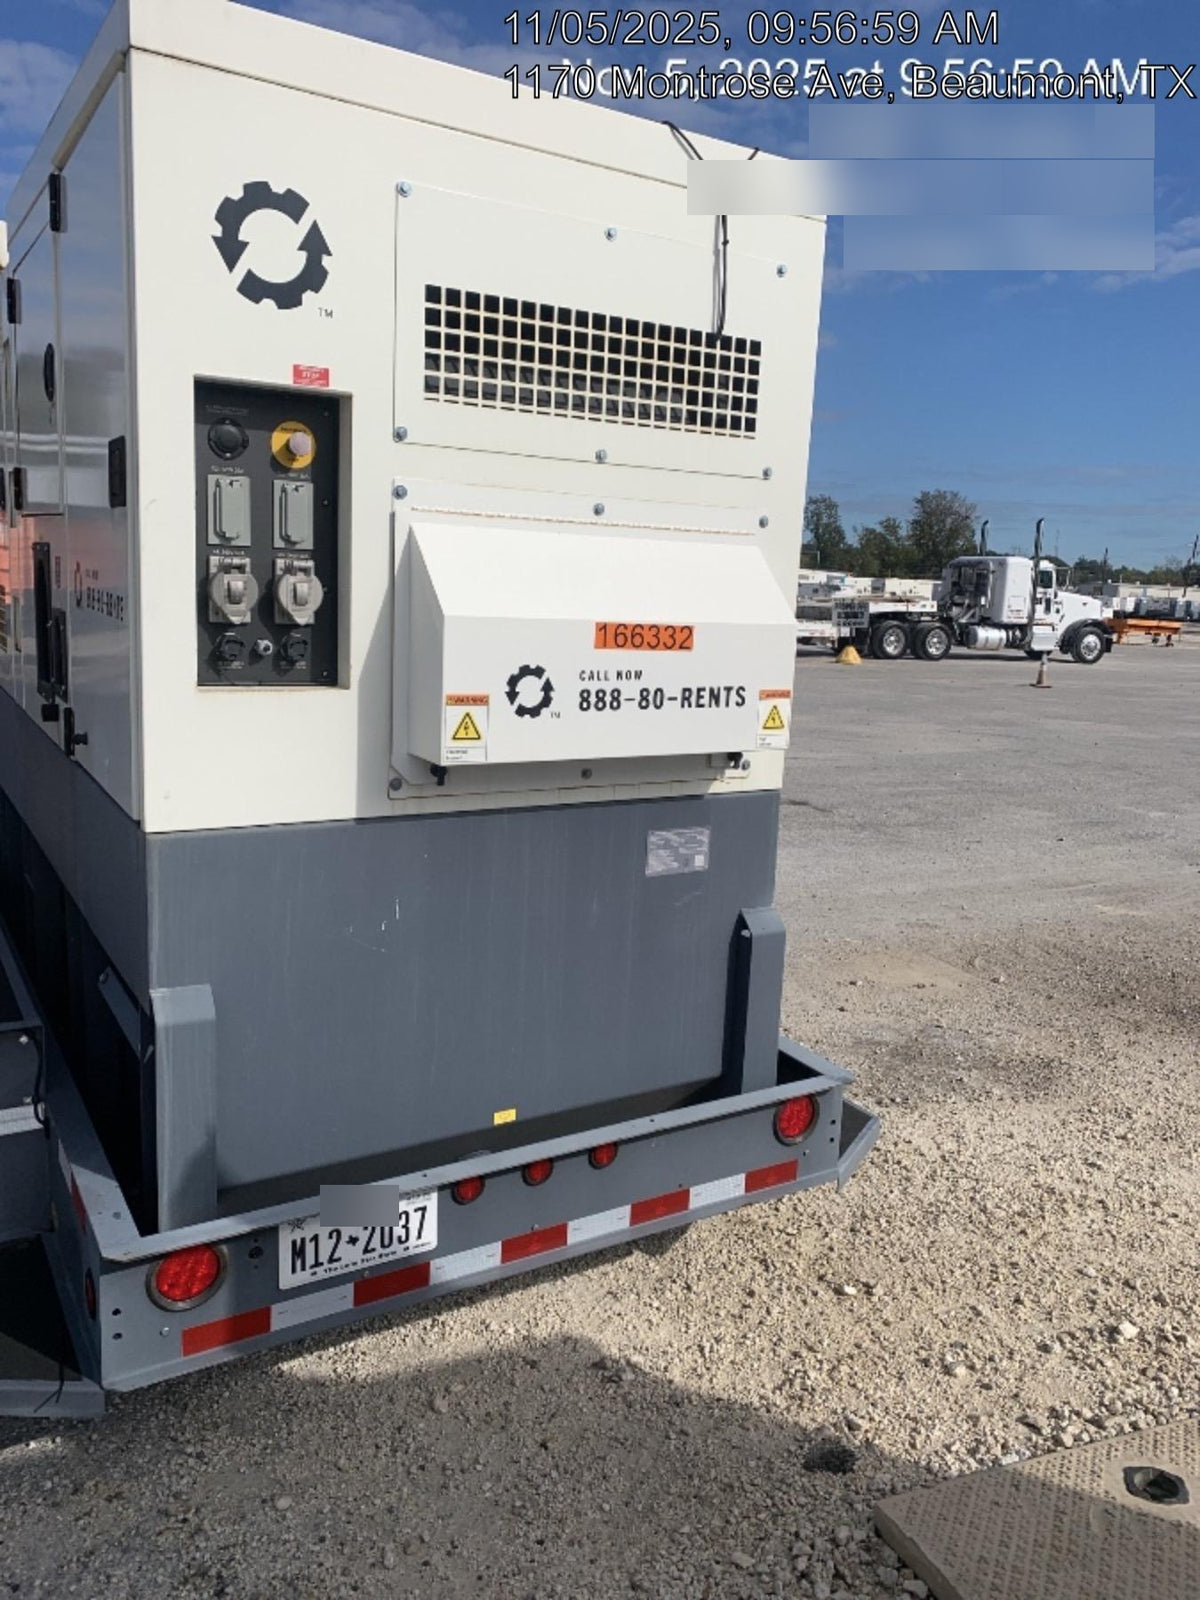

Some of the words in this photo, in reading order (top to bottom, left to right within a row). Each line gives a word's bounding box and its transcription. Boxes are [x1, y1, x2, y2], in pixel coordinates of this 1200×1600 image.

[598, 623, 693, 649] 166332
[578, 669, 611, 682] CALL
[616, 669, 643, 681] NOW
[578, 686, 747, 712] 888-80-RENTS
